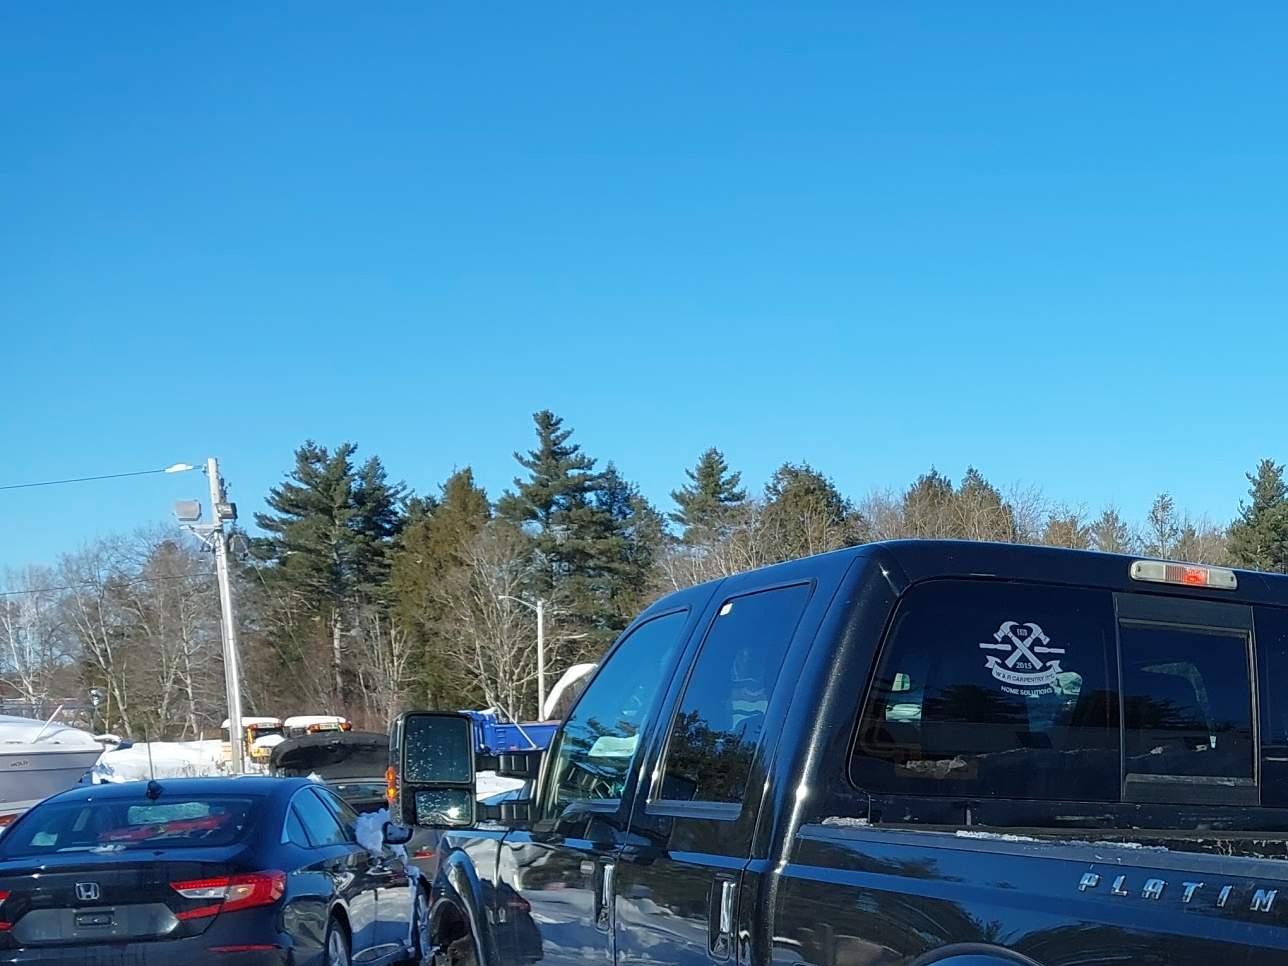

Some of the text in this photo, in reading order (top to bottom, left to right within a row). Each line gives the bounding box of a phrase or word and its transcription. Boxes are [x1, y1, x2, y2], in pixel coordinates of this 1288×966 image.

[1012, 675, 1044, 683] CARPENTRY
[1001, 685, 1053, 696] HOME SOLUTIONS
